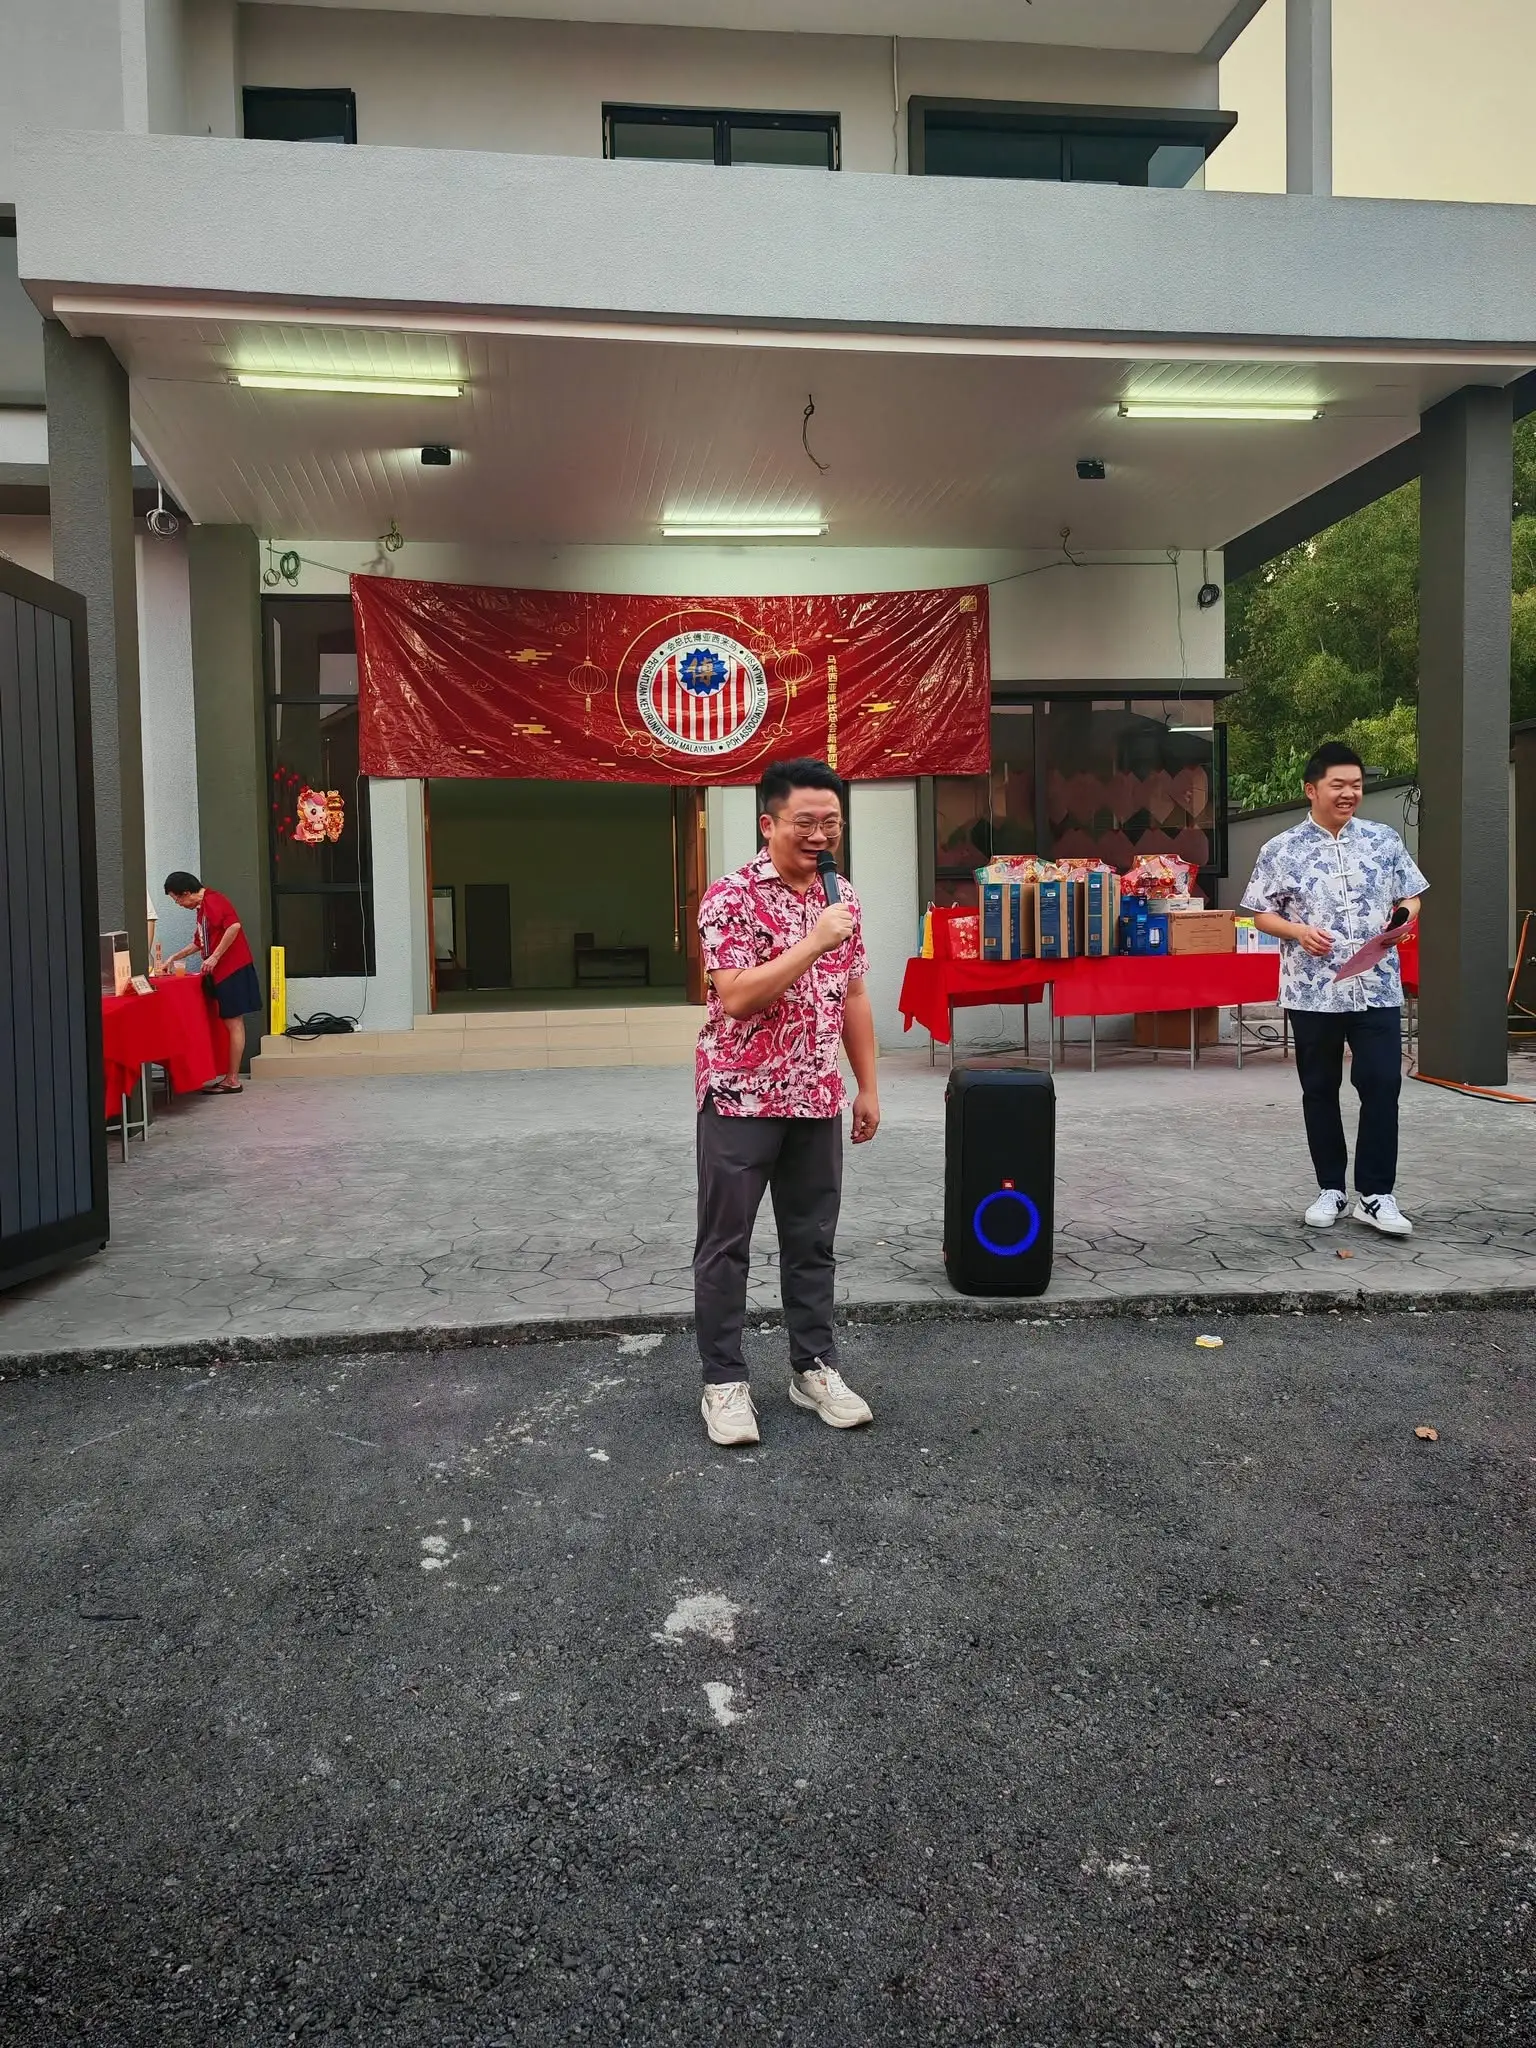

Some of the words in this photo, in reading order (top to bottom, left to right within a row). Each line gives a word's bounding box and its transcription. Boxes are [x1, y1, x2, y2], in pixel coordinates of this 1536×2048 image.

[639, 656, 659, 695] PERSATUAN
[743, 654, 765, 685] MALAYSIA
[757, 687, 766, 696] OF
[639, 697, 664, 737] KETURUNAN
[740, 697, 766, 739] ASSOCIATION
[663, 734, 678, 747] POH
[679, 741, 715, 753] MALAYSIA
[726, 736, 741, 749] POH
